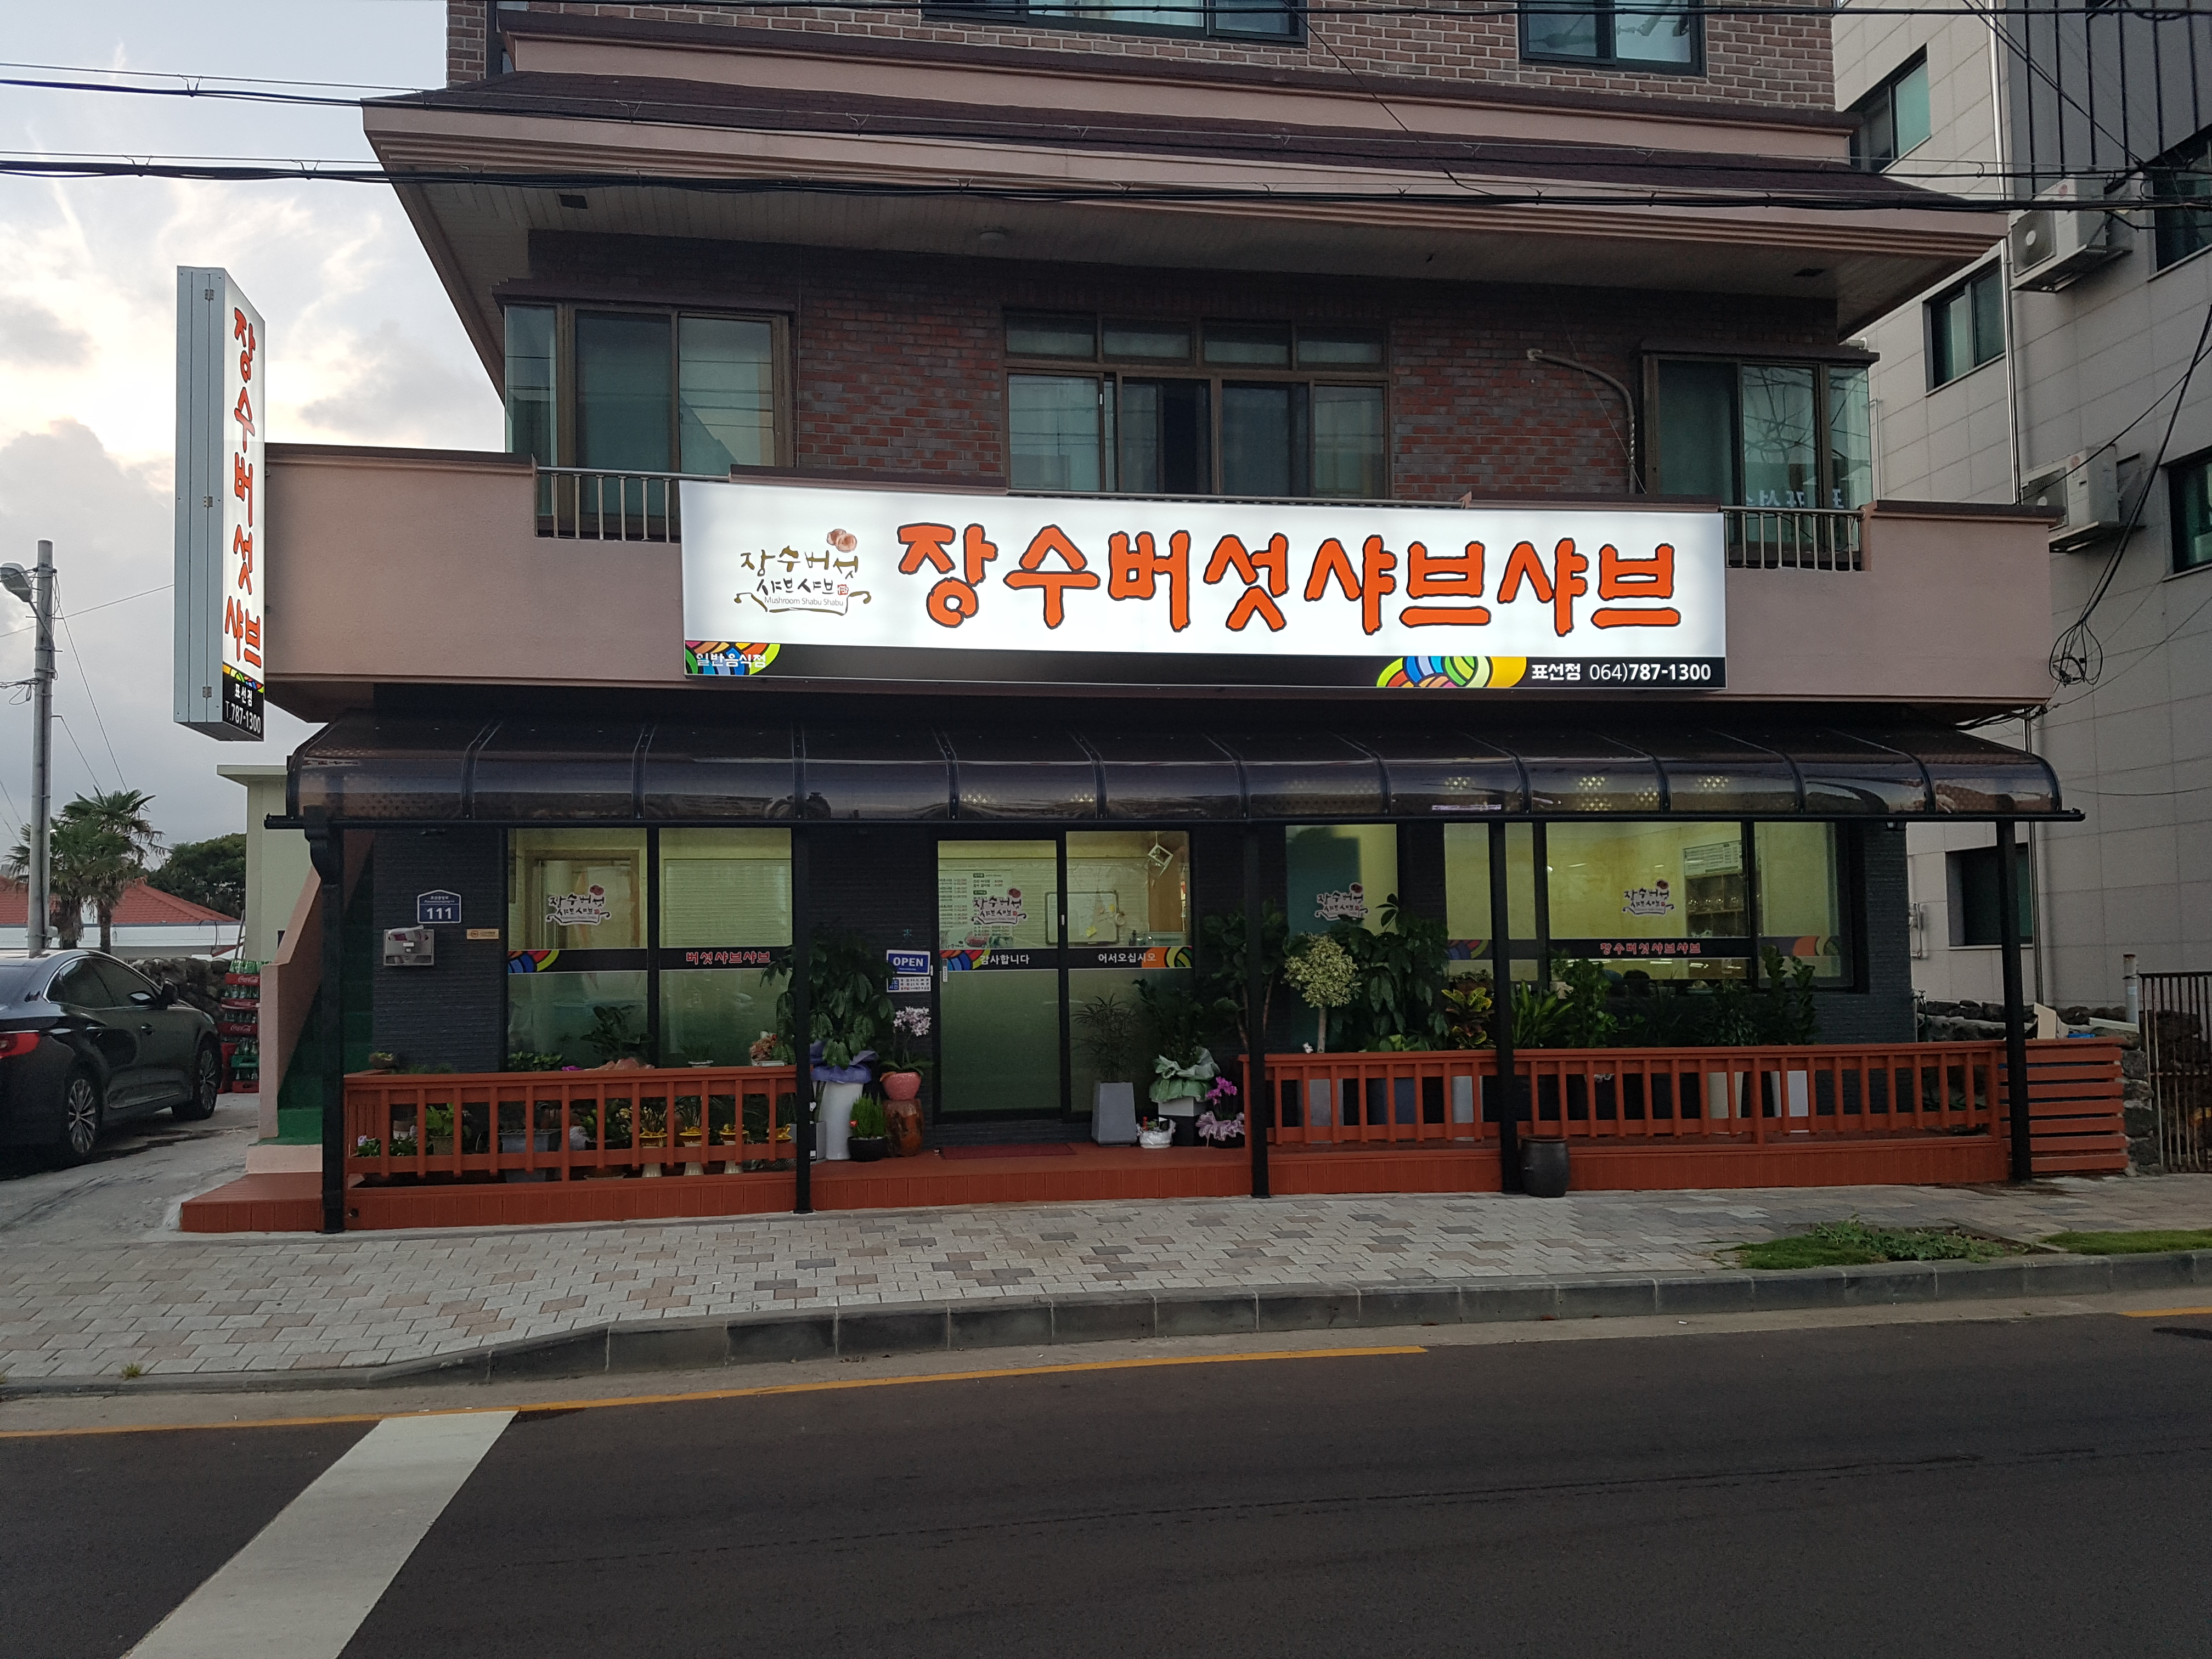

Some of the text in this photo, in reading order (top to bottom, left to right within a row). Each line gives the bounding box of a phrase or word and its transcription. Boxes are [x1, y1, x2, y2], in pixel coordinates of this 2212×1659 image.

[740, 545, 859, 579] 장수버섯
[757, 578, 834, 596] 샤브샤브
[896, 523, 1681, 637] 장수버섯샤브샤브
[764, 596, 800, 605] Mushroom
[823, 598, 844, 606] Shabu
[696, 653, 766, 668] 일반음식점
[1531, 663, 1711, 682] 표선점 064)787-1300
[235, 683, 252, 707] 표선점
[225, 701, 261, 734] T.787-1300
[426, 907, 452, 919] 111
[1600, 942, 1701, 955] 장수버섯샤브샤브
[686, 951, 770, 965] 버섯샤브샤브
[893, 957, 923, 967] OPEN
[980, 954, 1030, 965] 감사합니다
[1098, 952, 1157, 964] 어서오십시오
